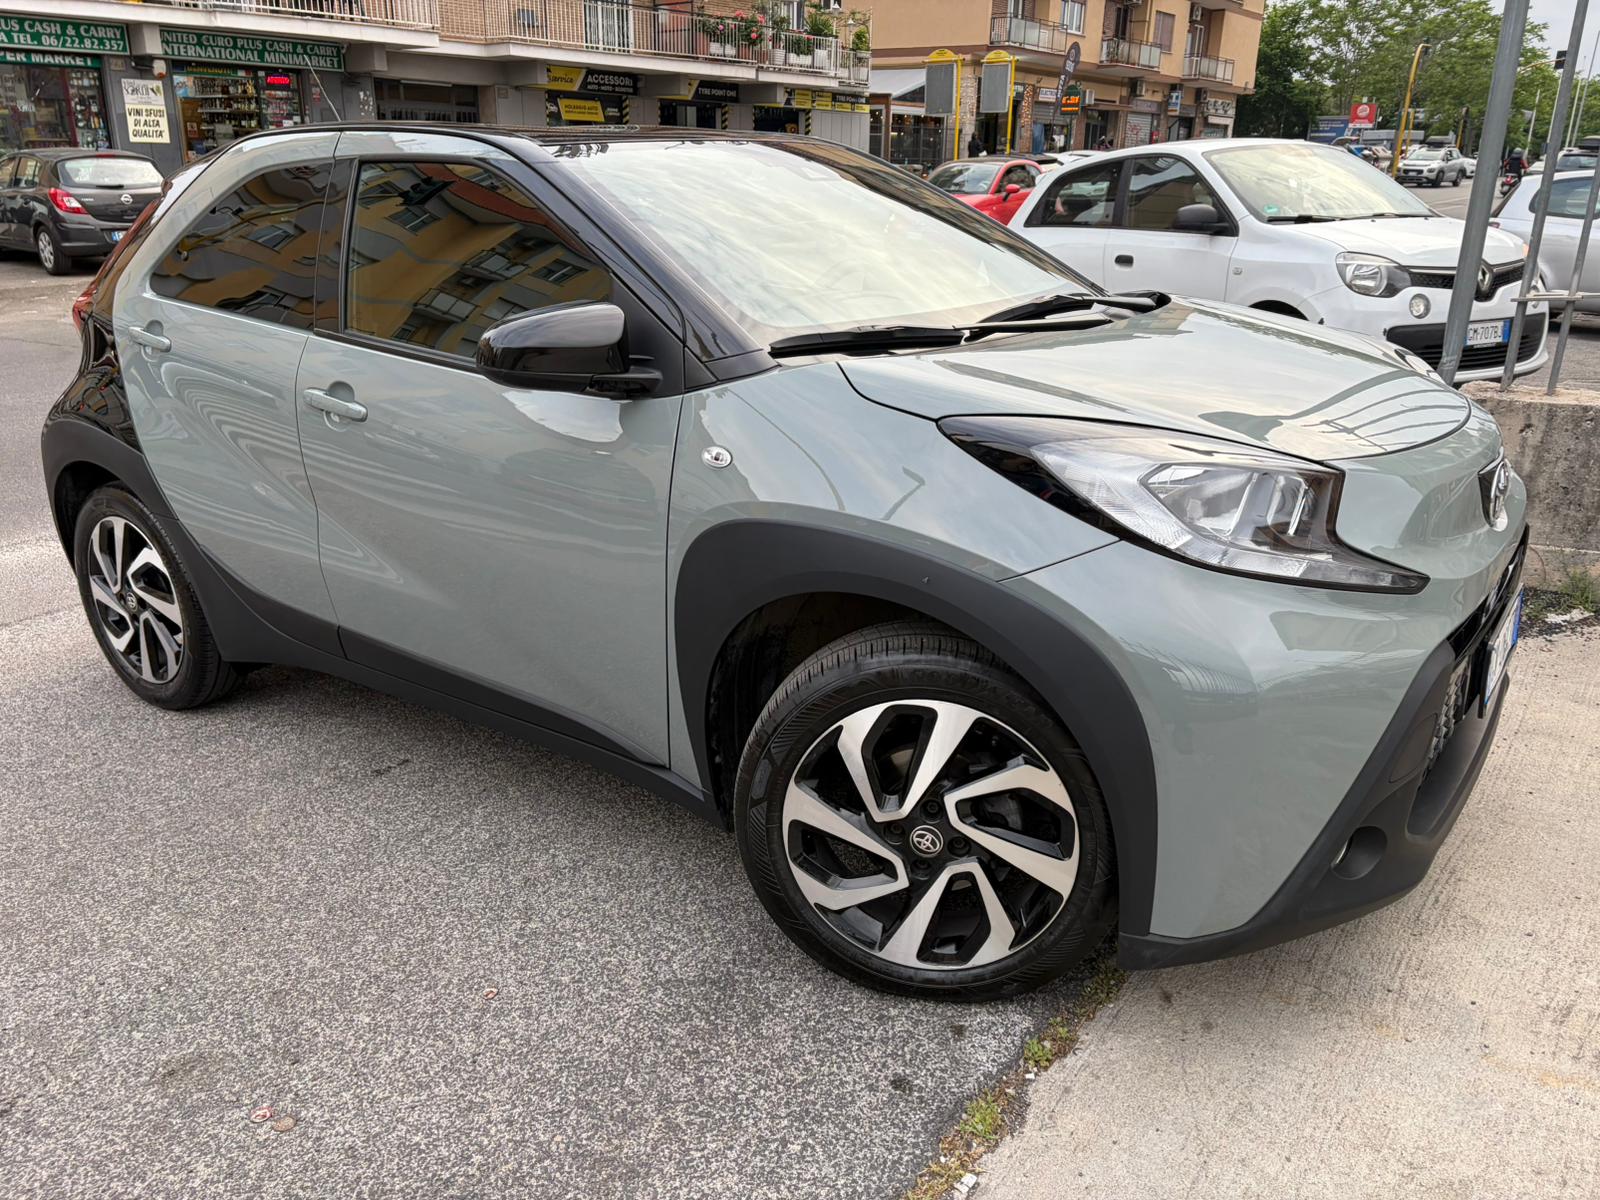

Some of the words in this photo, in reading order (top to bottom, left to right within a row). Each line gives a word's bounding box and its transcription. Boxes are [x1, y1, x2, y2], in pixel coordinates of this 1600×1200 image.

[0, 18, 20, 31] US
[24, 20, 61, 35] CASH
[66, 24, 76, 36] &
[80, 25, 122, 39] CARRY
[11, 32, 38, 45] TEL.
[42, 34, 124, 51] 06/22.82.357
[237, 38, 263, 51] PLUS
[265, 41, 293, 54] CASH
[296, 44, 304, 54] &
[307, 44, 338, 57] CARRY
[31, 53, 93, 66] MARKET
[162, 42, 261, 62] NTERNATIONAL
[264, 51, 339, 69] MINIMARKET
[128, 107, 144, 117] VINI
[145, 108, 165, 118] SFUSI
[134, 118, 141, 128] DI
[143, 119, 160, 128] ALTA
